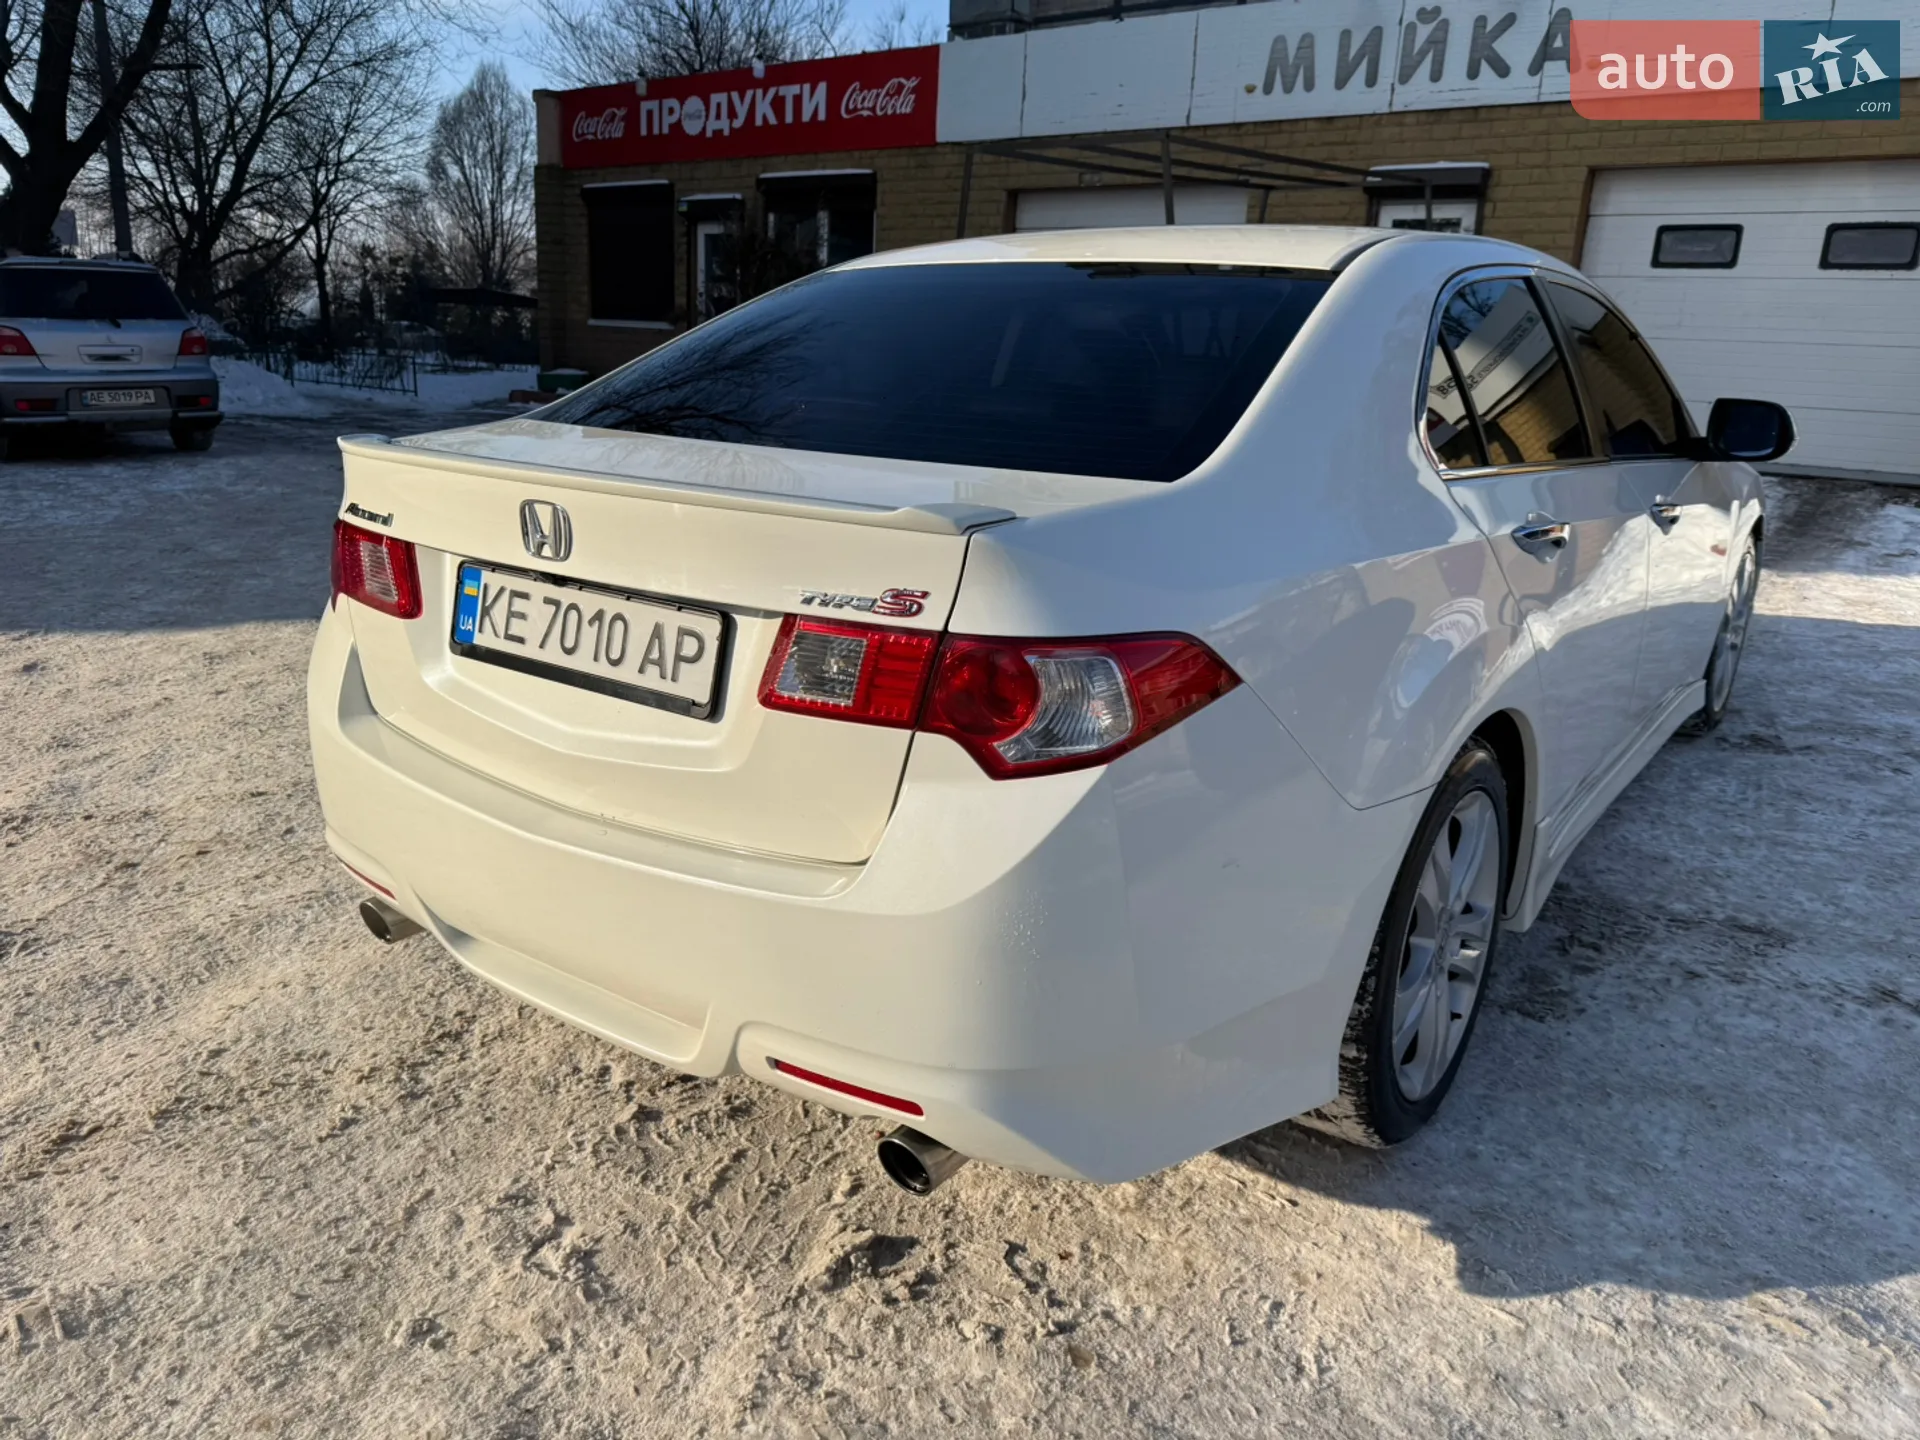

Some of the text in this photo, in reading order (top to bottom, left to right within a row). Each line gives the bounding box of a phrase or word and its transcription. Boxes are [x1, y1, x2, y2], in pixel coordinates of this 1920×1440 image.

[1262, 5, 1581, 96] МИЙКА
[640, 81, 828, 138] ПРОДУКТИ
[840, 76, 921, 119] Coca-Cola
[89, 390, 152, 403] AE 5019 PA
[459, 615, 473, 632] UA
[872, 588, 931, 617] S
[478, 583, 706, 683] KE 7010 AP
